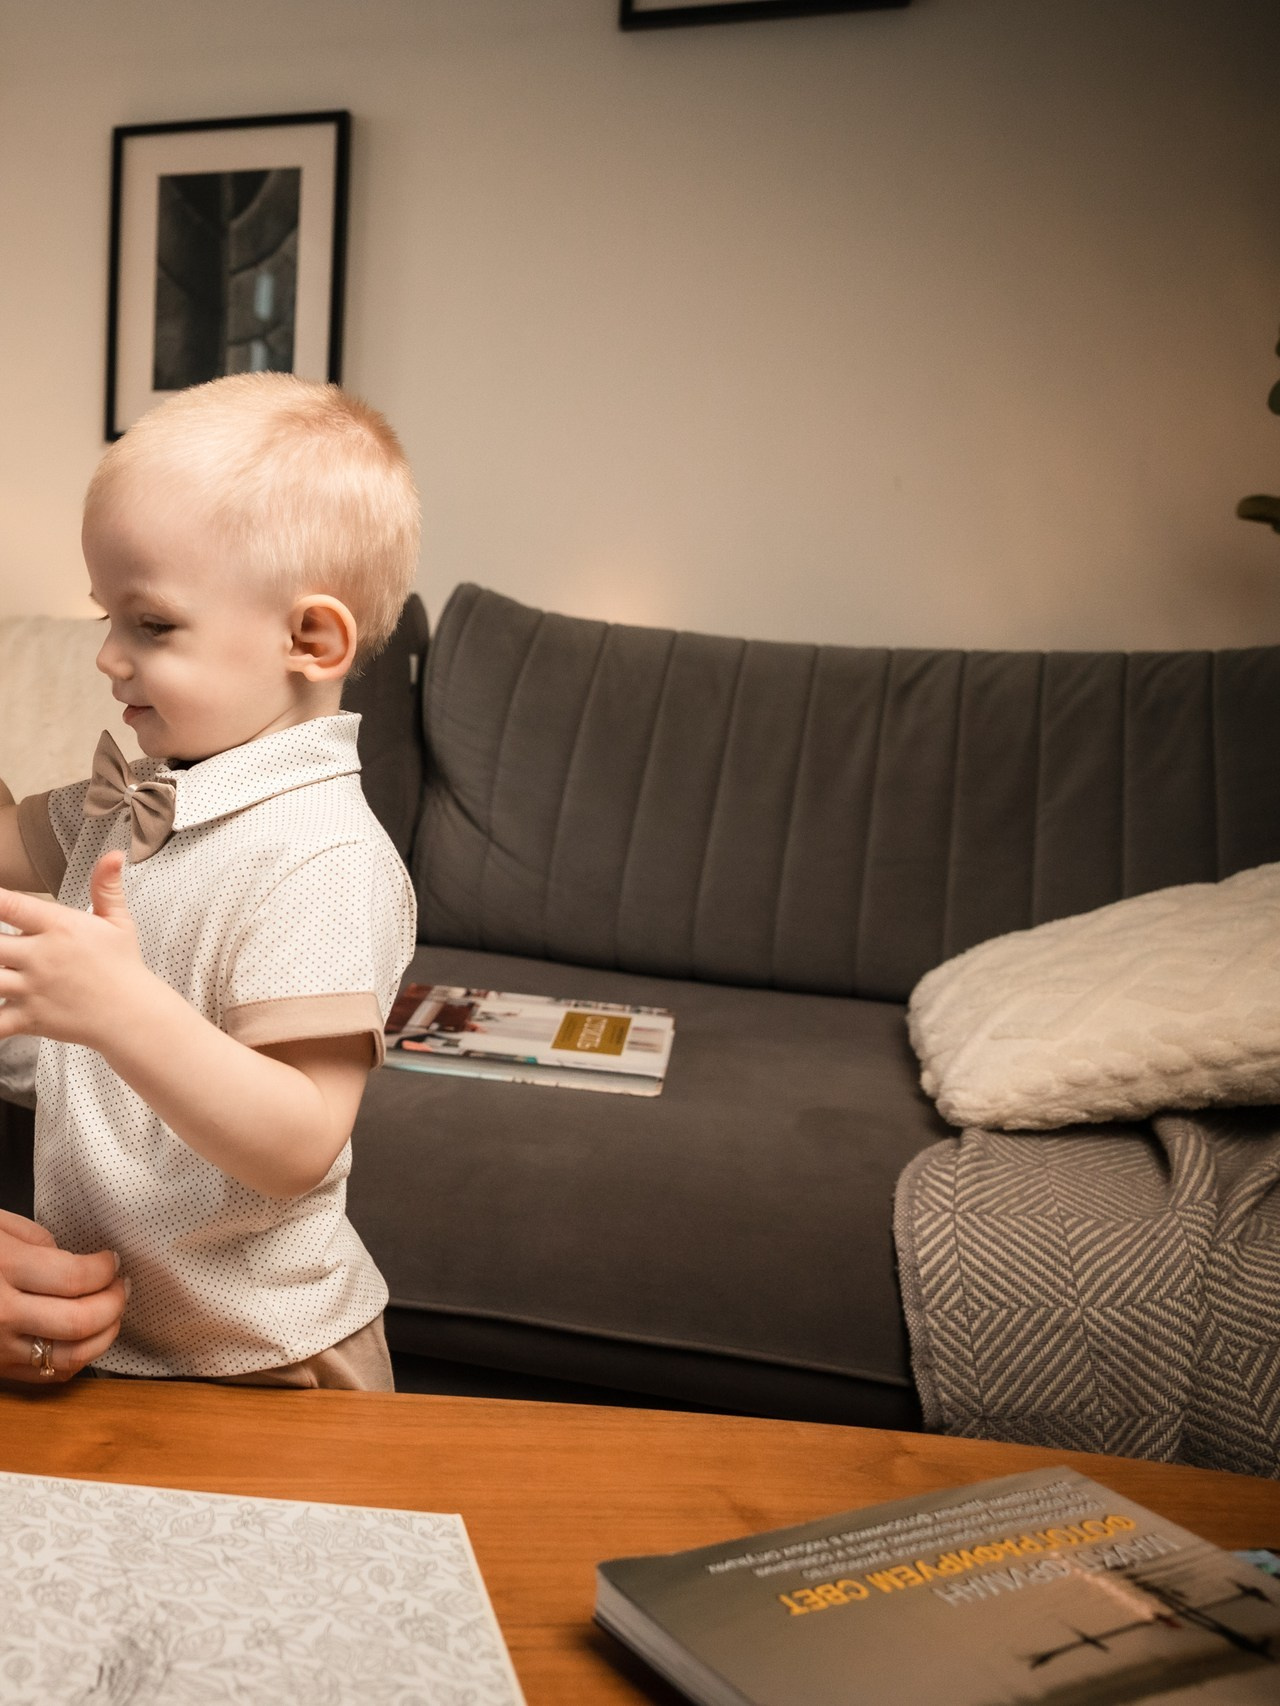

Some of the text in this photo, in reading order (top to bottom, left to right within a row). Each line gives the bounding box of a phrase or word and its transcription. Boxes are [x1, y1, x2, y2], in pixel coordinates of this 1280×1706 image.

[777, 1514, 1137, 1617] ФОТОГРАФИРУЕМ СВЕТ
[931, 1560, 1070, 1607] ФРИМАН
